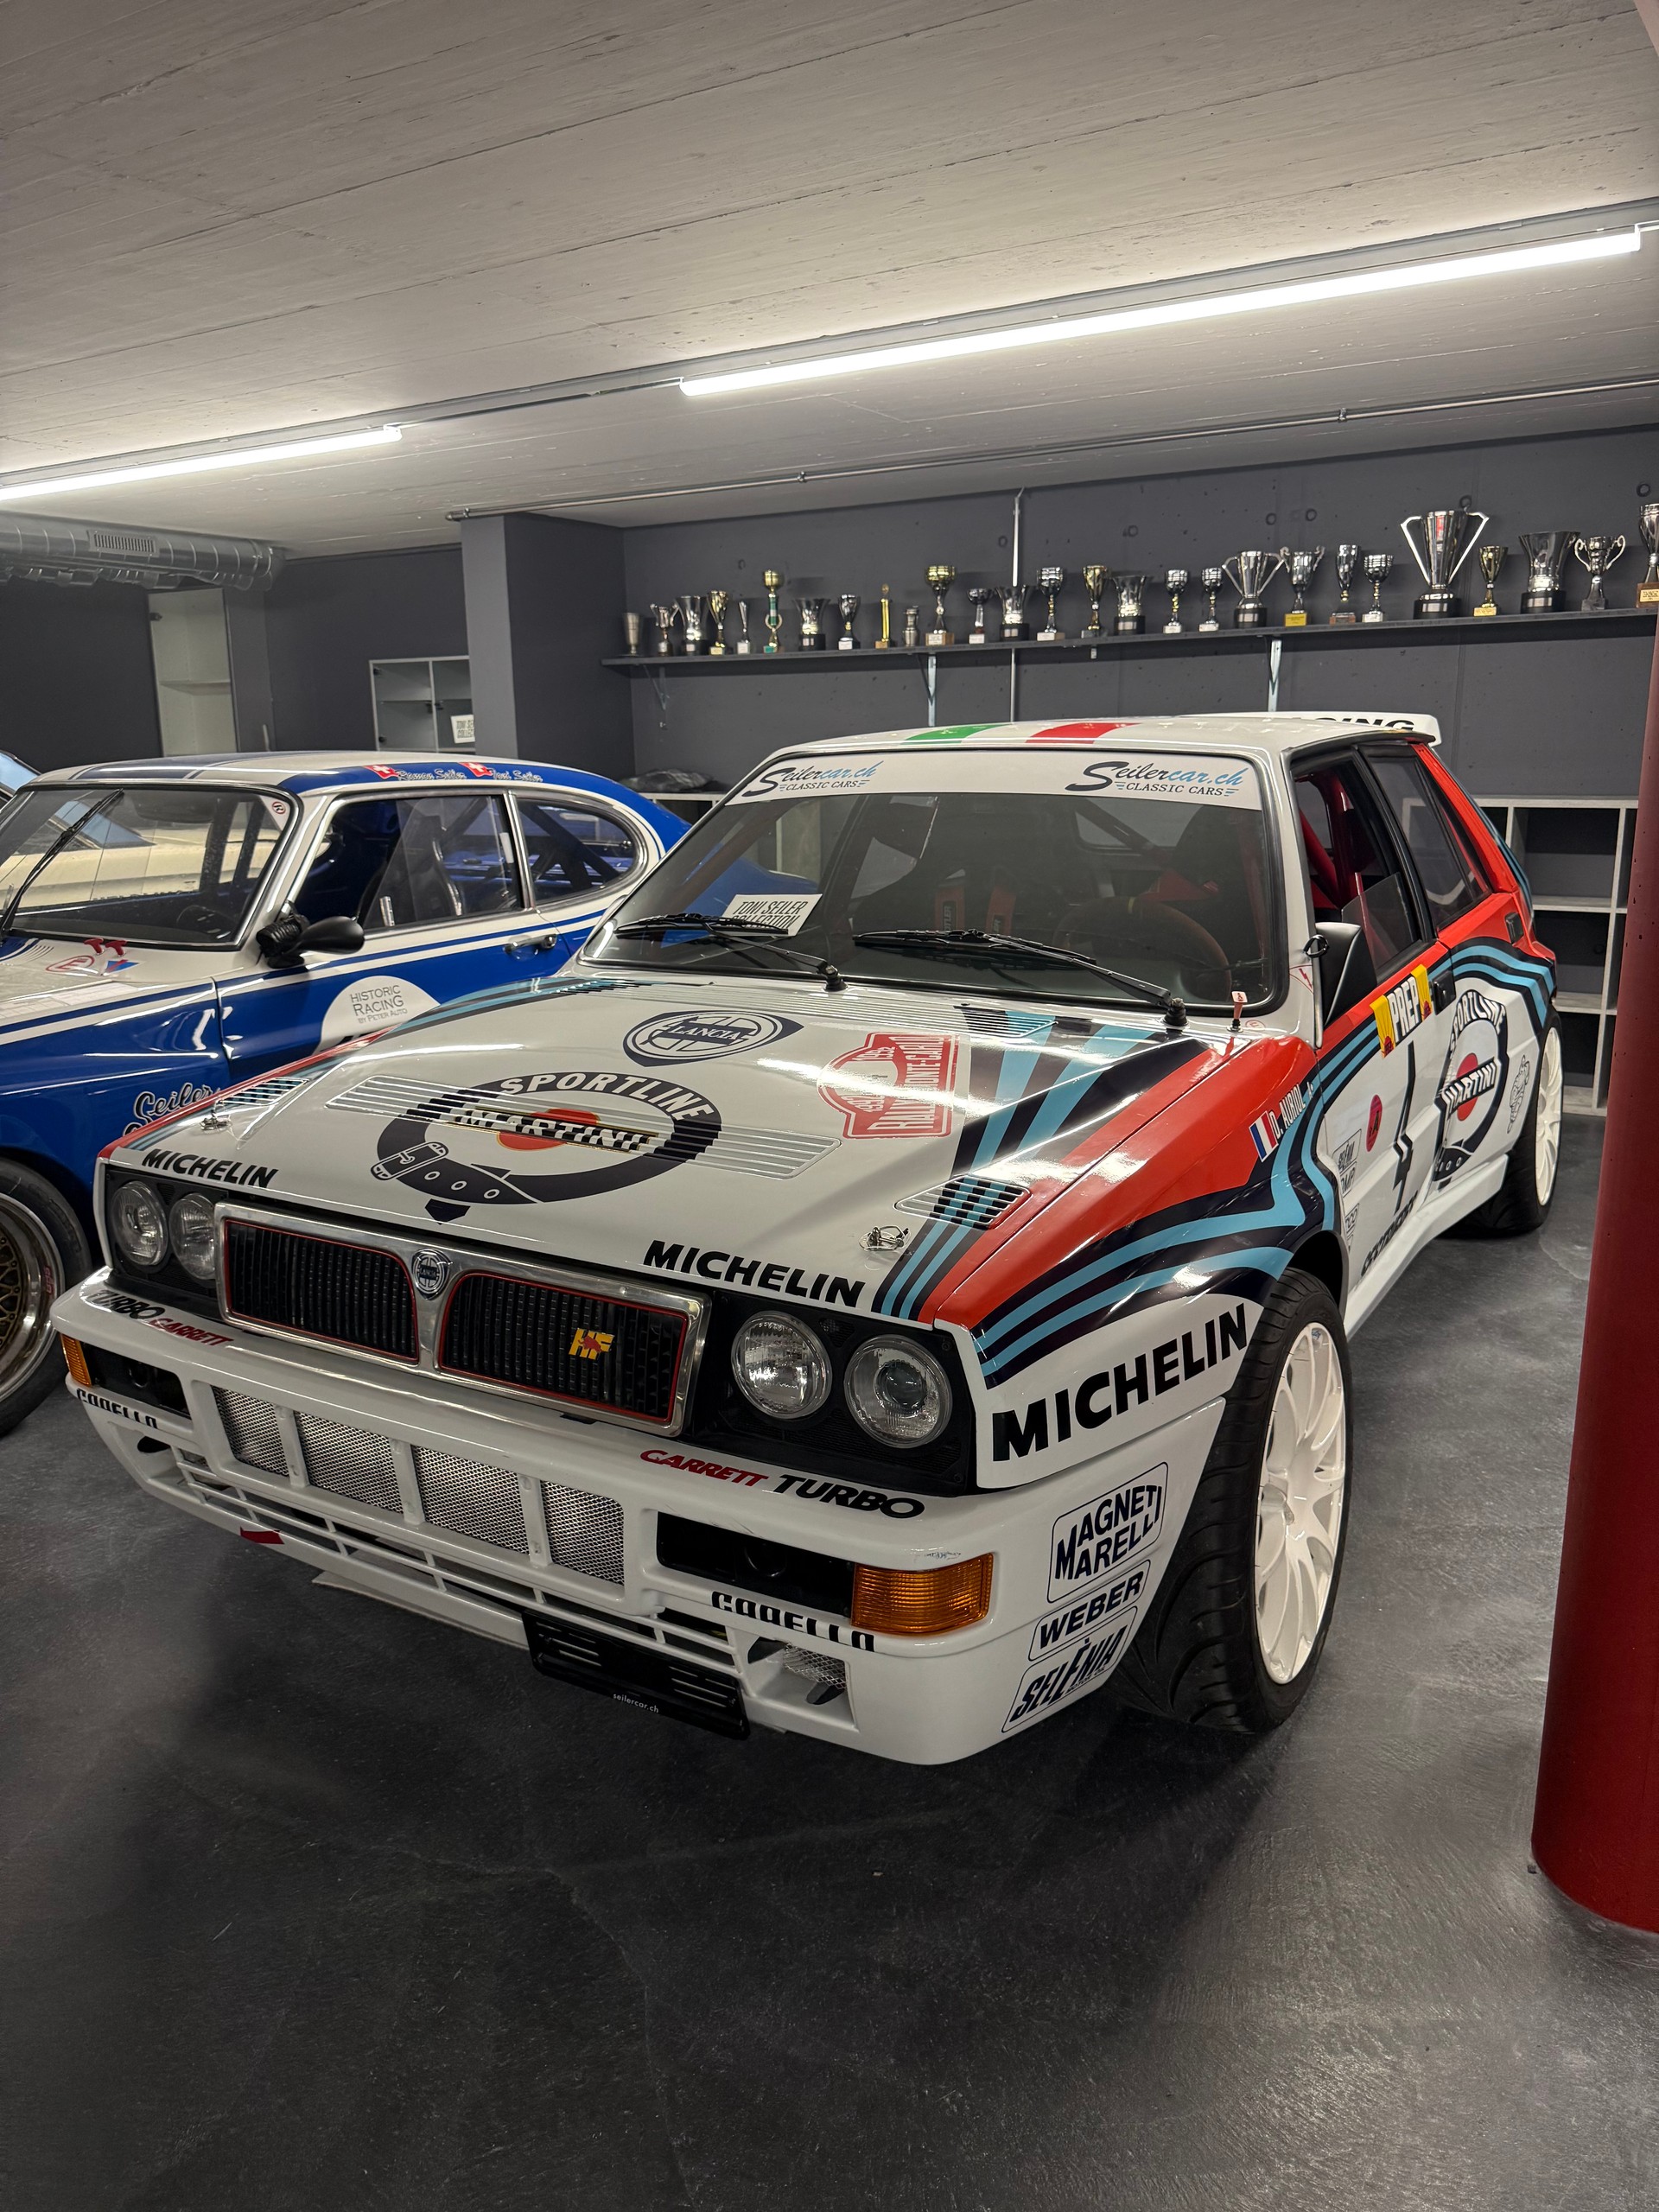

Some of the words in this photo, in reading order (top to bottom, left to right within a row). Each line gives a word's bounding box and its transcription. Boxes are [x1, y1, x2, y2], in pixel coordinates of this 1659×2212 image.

[785, 781, 830, 791] CLASSIC
[830, 780, 858, 789] CARS
[1126, 782, 1185, 793] CLASSIC
[1188, 785, 1224, 797] CARS
[733, 901, 767, 915] TONI
[761, 901, 808, 915] SEILER
[350, 984, 401, 1003] HISTORIC
[353, 995, 404, 1016] RACING
[1387, 976, 1420, 1043] PREP
[668, 1026, 742, 1040] LANCIA
[499, 1072, 715, 1121] SPORTLINE
[1443, 1061, 1496, 1115] MARTINI
[460, 1110, 645, 1150] MARTINI
[1268, 1110, 1284, 1140] D.
[142, 1148, 278, 1189] MICHELIN
[643, 1240, 866, 1308] MICHELIN
[86, 1290, 165, 1319] TURBO
[148, 1318, 234, 1346] GARRETT
[569, 1328, 614, 1360] HF
[992, 1302, 1249, 1462] MICHELIN
[639, 1450, 770, 1487] GARRETT
[773, 1474, 925, 1518] TURBO
[1039, 1571, 1144, 1649] WEBER
[613, 1692, 659, 1713] seilercar.ch
